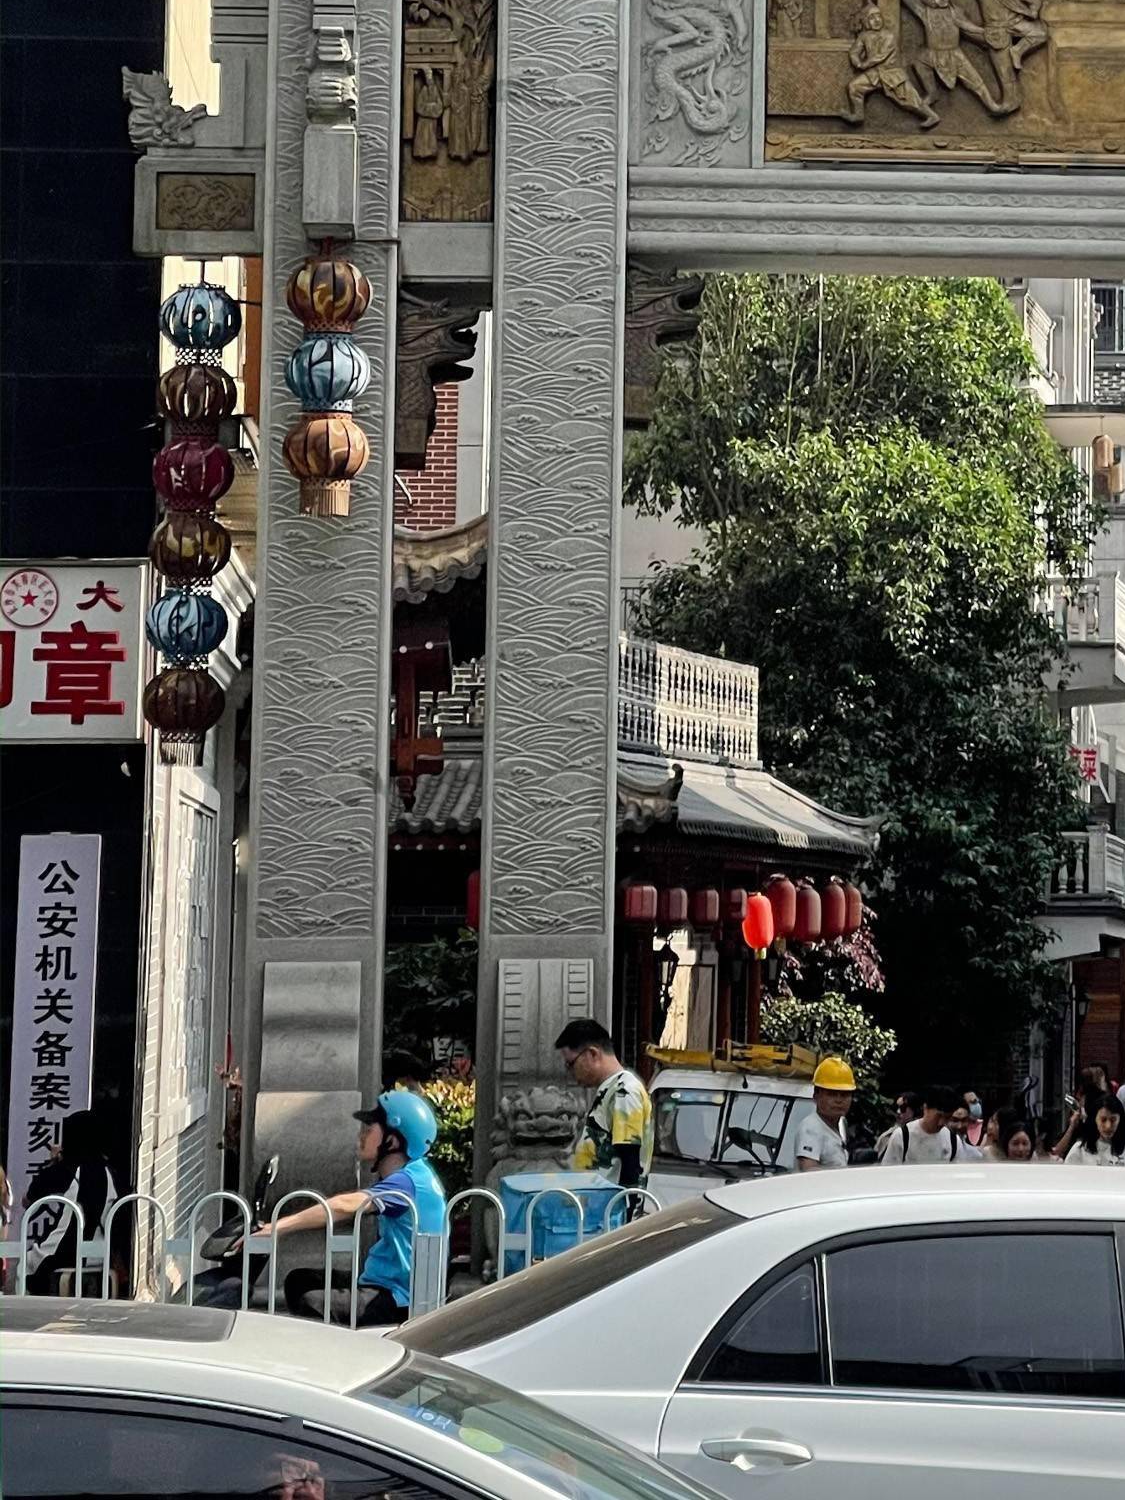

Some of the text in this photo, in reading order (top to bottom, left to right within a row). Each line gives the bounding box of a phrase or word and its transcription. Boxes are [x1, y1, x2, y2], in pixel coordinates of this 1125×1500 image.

[26, 858, 81, 1244] 公安机关备案刻企
